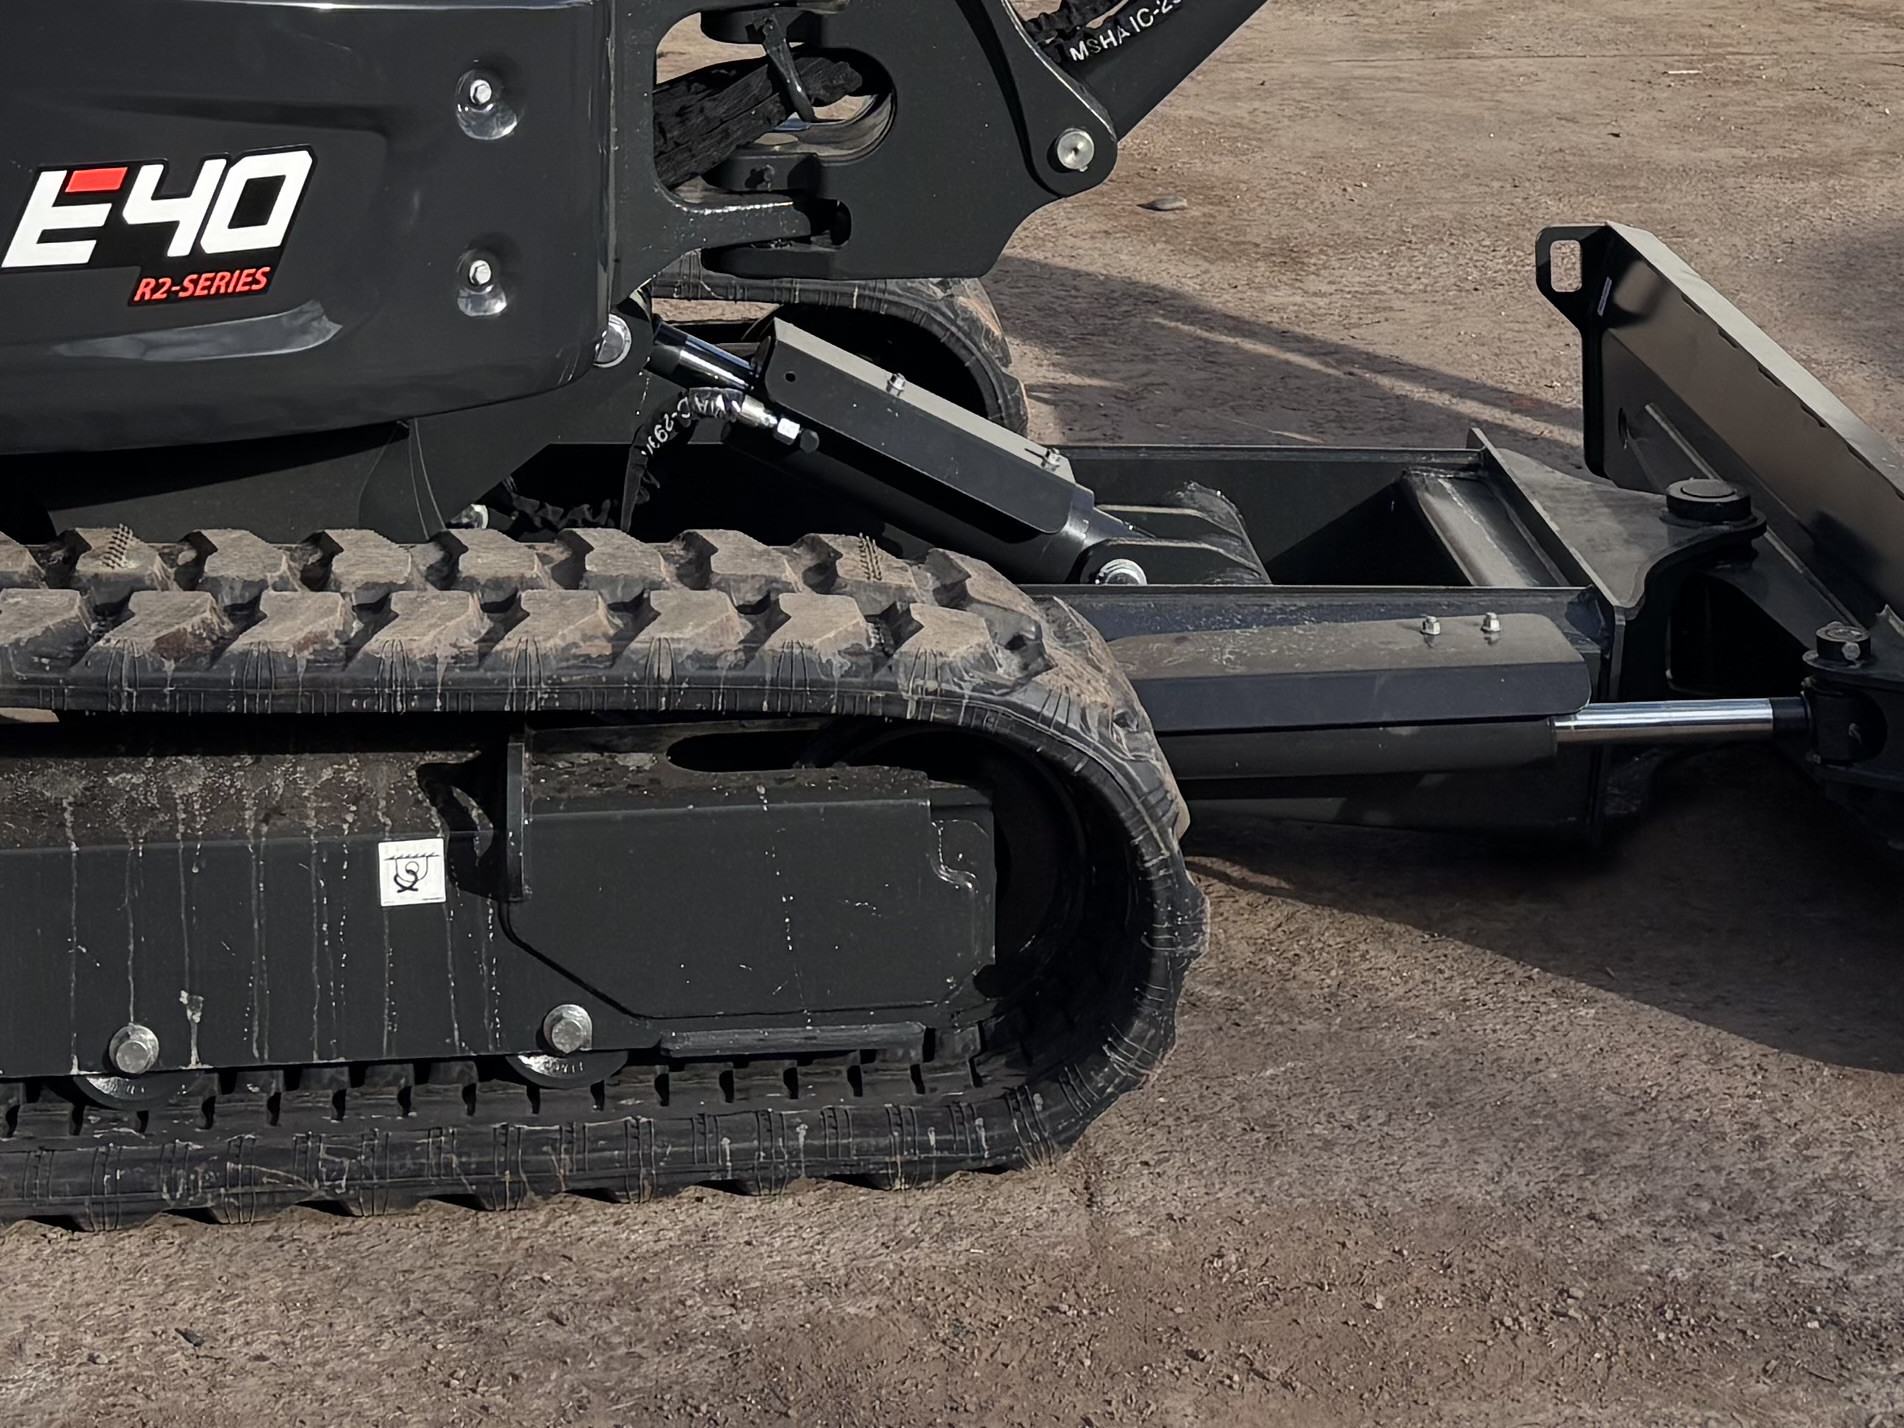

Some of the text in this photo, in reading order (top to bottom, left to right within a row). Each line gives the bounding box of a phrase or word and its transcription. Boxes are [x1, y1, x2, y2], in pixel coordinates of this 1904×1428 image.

[1069, 25, 1131, 62] MSHA
[0, 149, 314, 269] E40
[132, 265, 272, 303] R2-SERIES
